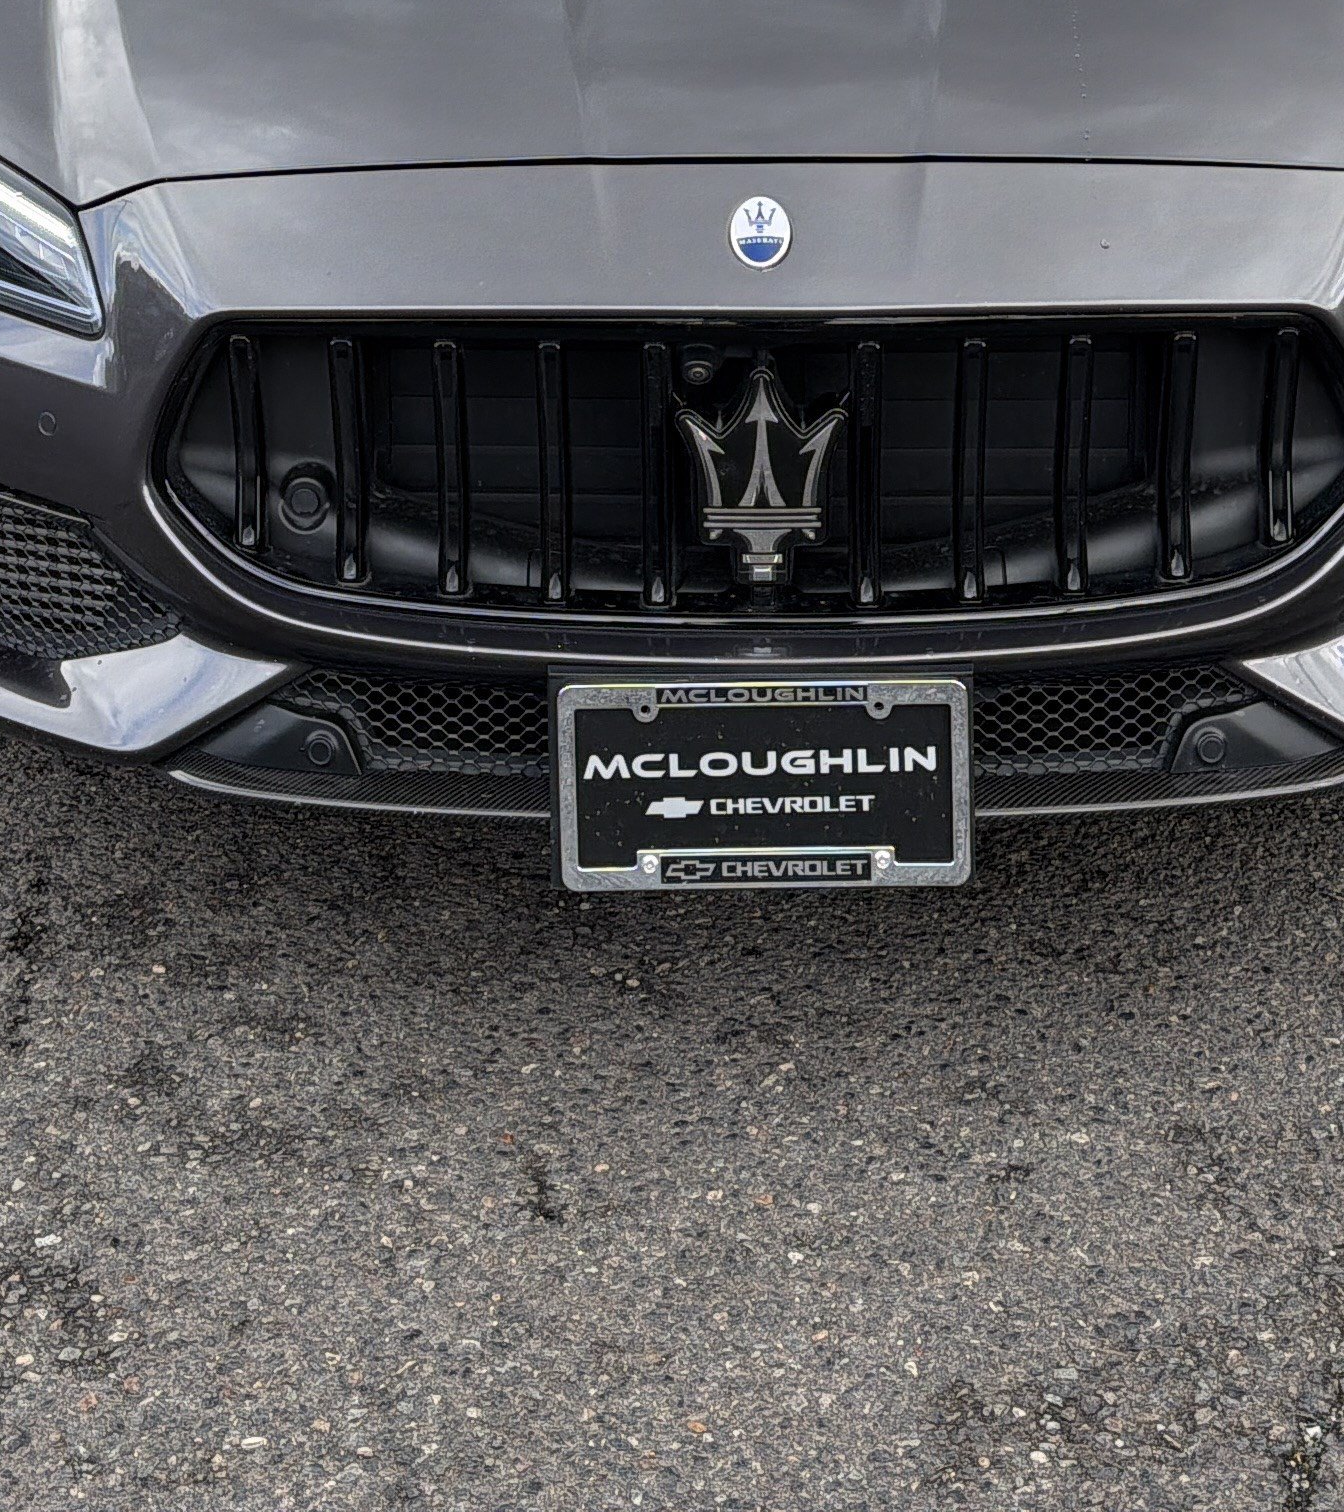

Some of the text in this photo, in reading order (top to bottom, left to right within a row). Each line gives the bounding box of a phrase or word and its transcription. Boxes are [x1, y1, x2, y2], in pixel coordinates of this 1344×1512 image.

[660, 686, 865, 703] MCLOUGHLIN
[582, 745, 938, 780] MCLOUGHLIN
[709, 794, 876, 815] CHEVROLET
[720, 858, 868, 878] CHEVROLET
